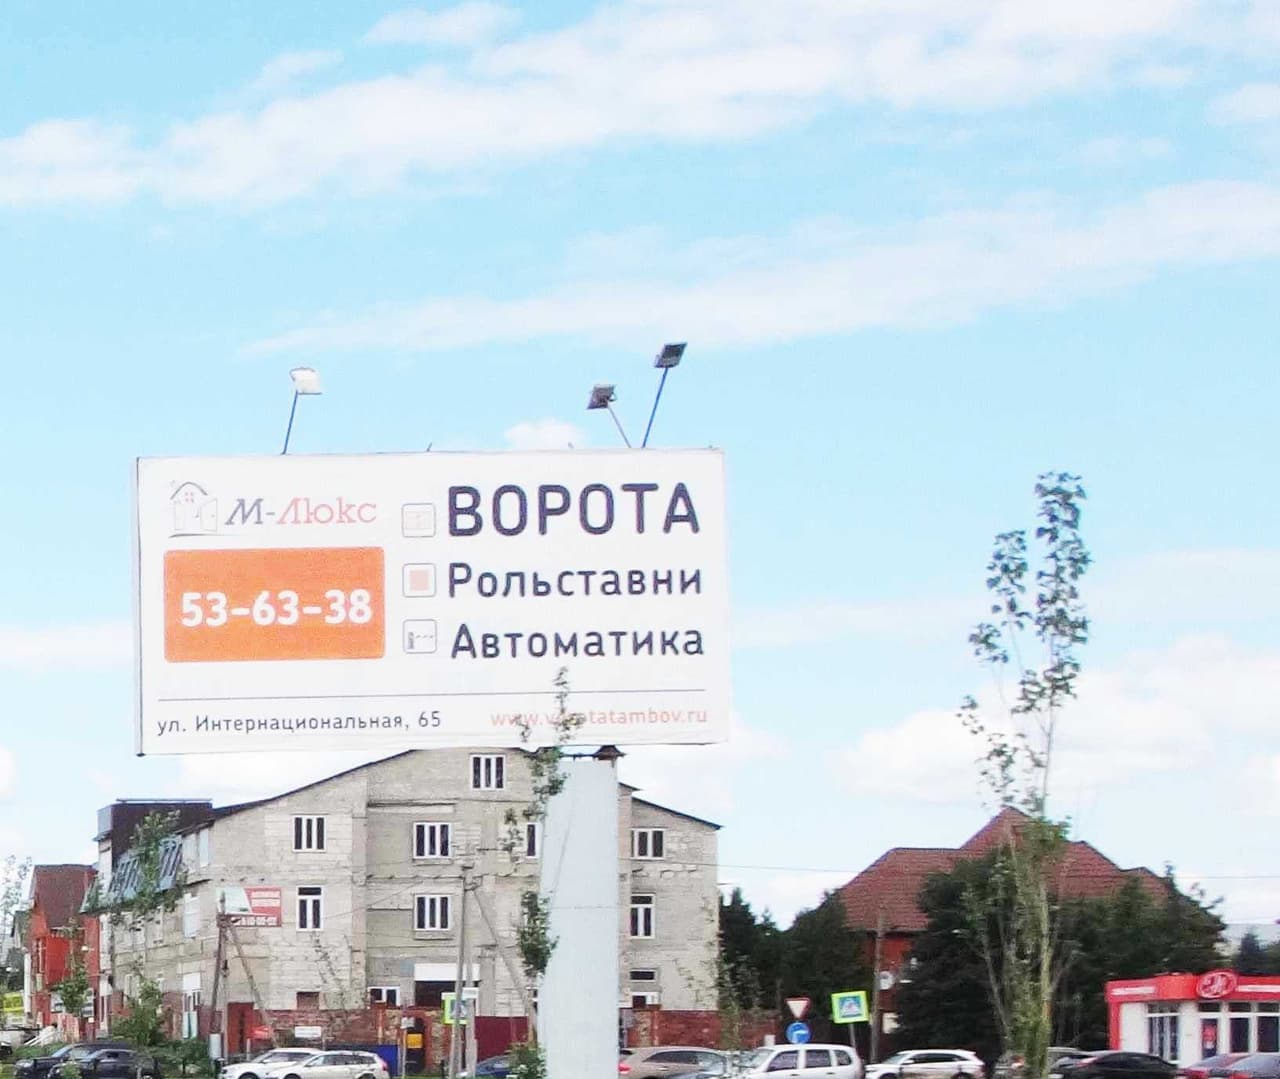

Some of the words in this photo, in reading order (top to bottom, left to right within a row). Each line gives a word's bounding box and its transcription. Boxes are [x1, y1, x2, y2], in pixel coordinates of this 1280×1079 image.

[225, 497, 377, 525] М-Люкс
[448, 482, 700, 536] ВОРОТА
[448, 562, 702, 598] Рольставни
[181, 589, 373, 627] 53-63-38
[451, 623, 704, 658] Автоматика
[157, 719, 187, 736] ул.
[196, 713, 409, 734] Интернациональная,
[418, 710, 441, 728] 65
[491, 707, 708, 727] www.vtatambov.ru
